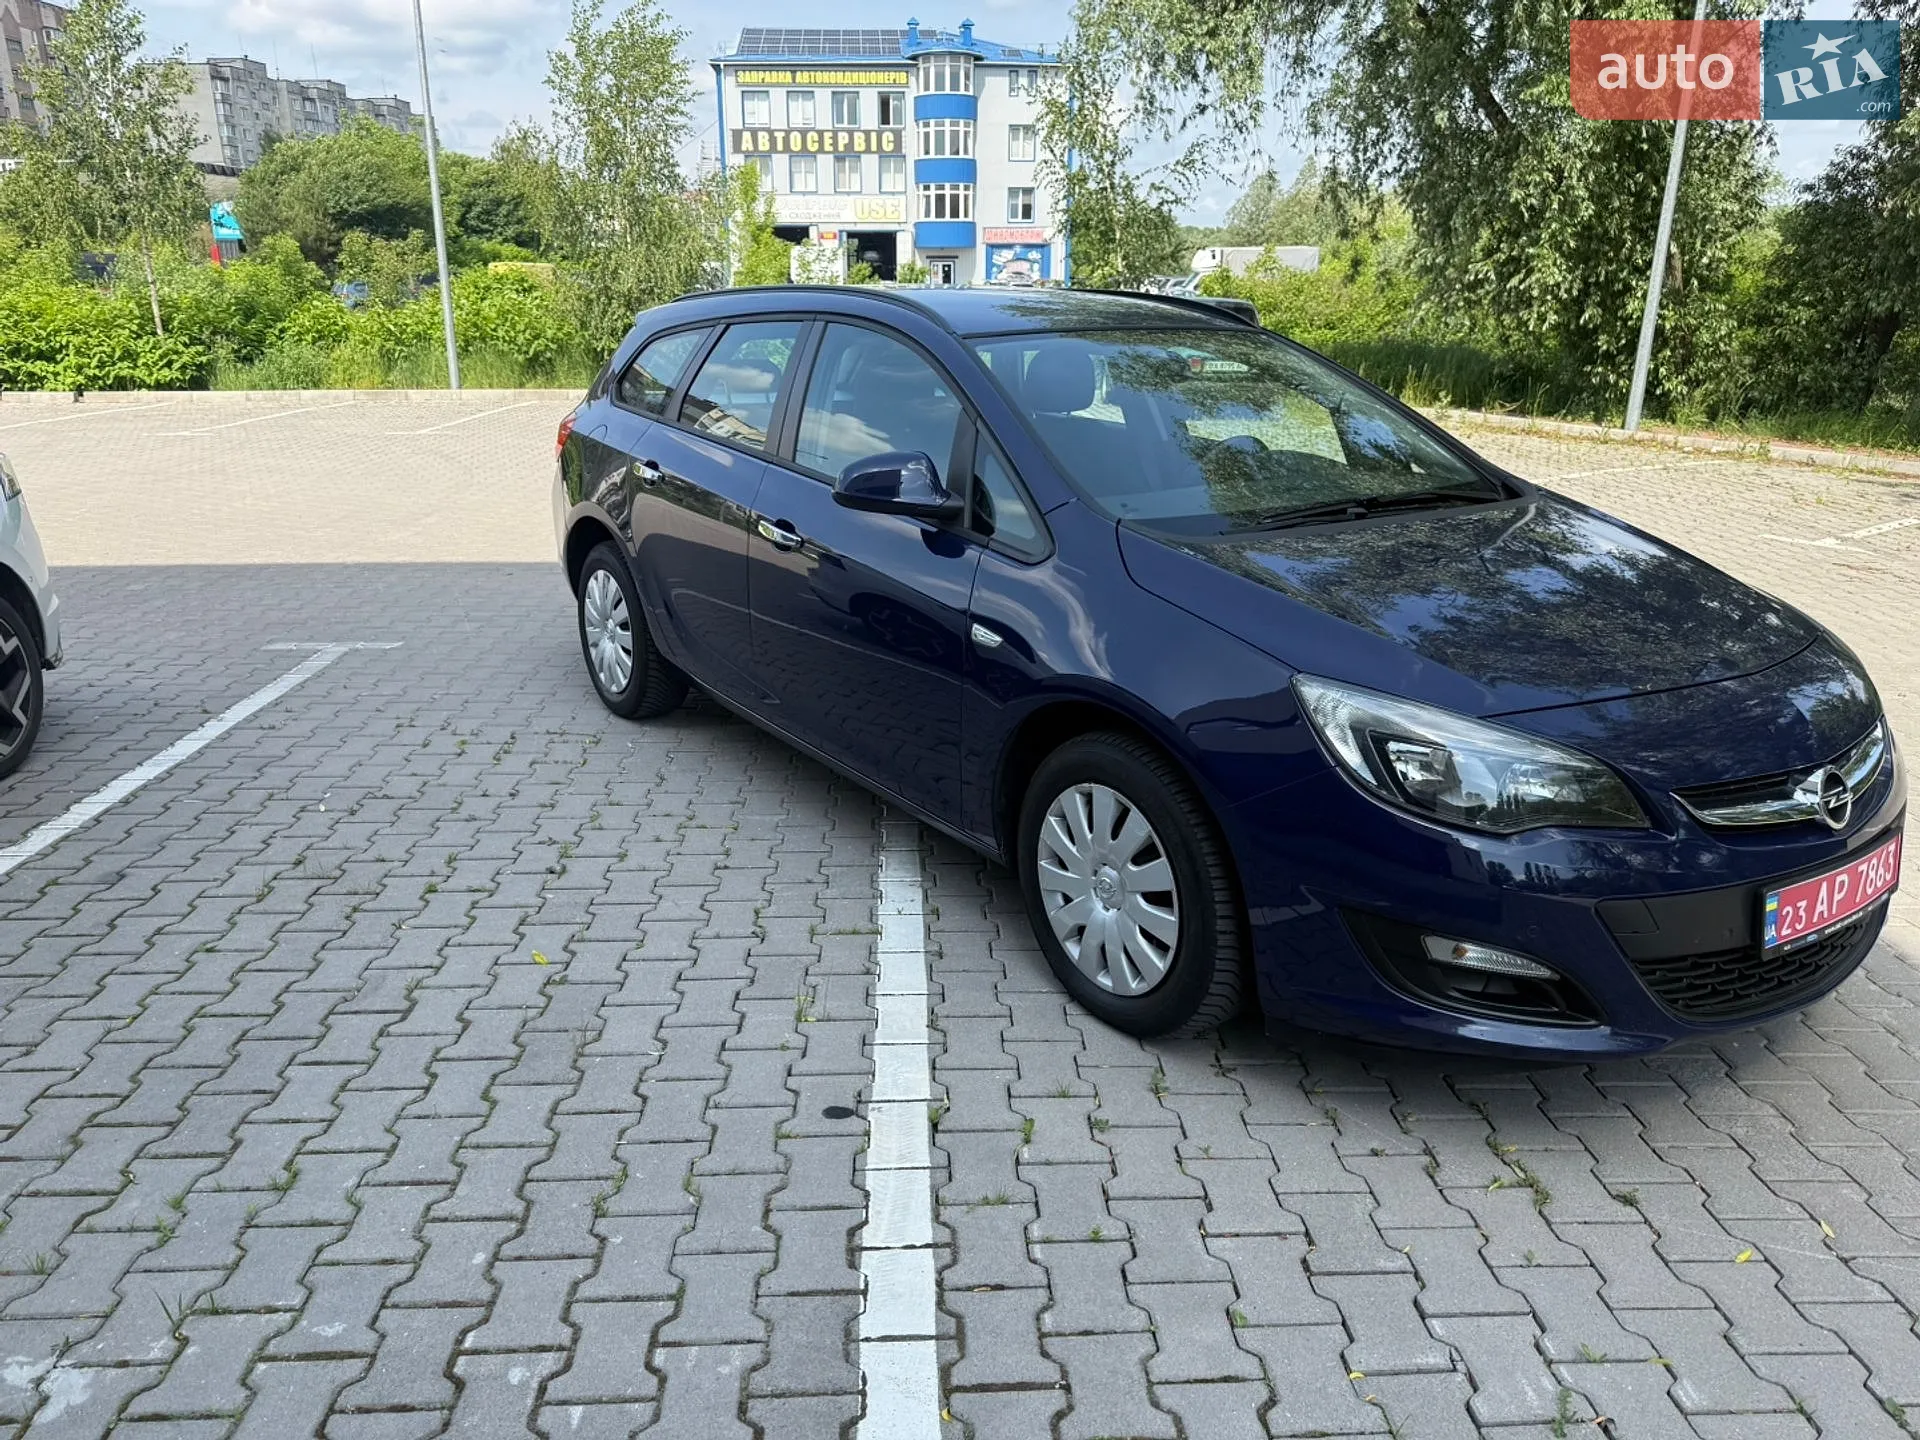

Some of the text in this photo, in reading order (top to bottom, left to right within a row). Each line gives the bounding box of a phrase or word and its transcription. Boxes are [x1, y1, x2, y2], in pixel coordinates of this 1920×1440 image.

[736, 70, 793, 84] ЗАПРАВКА
[740, 130, 896, 152] АВТОСЕРВІС
[1764, 923, 1777, 941] UA
[1780, 900, 1808, 936] 23
[1812, 873, 1849, 923] AP
[1855, 842, 1897, 903] 7863
